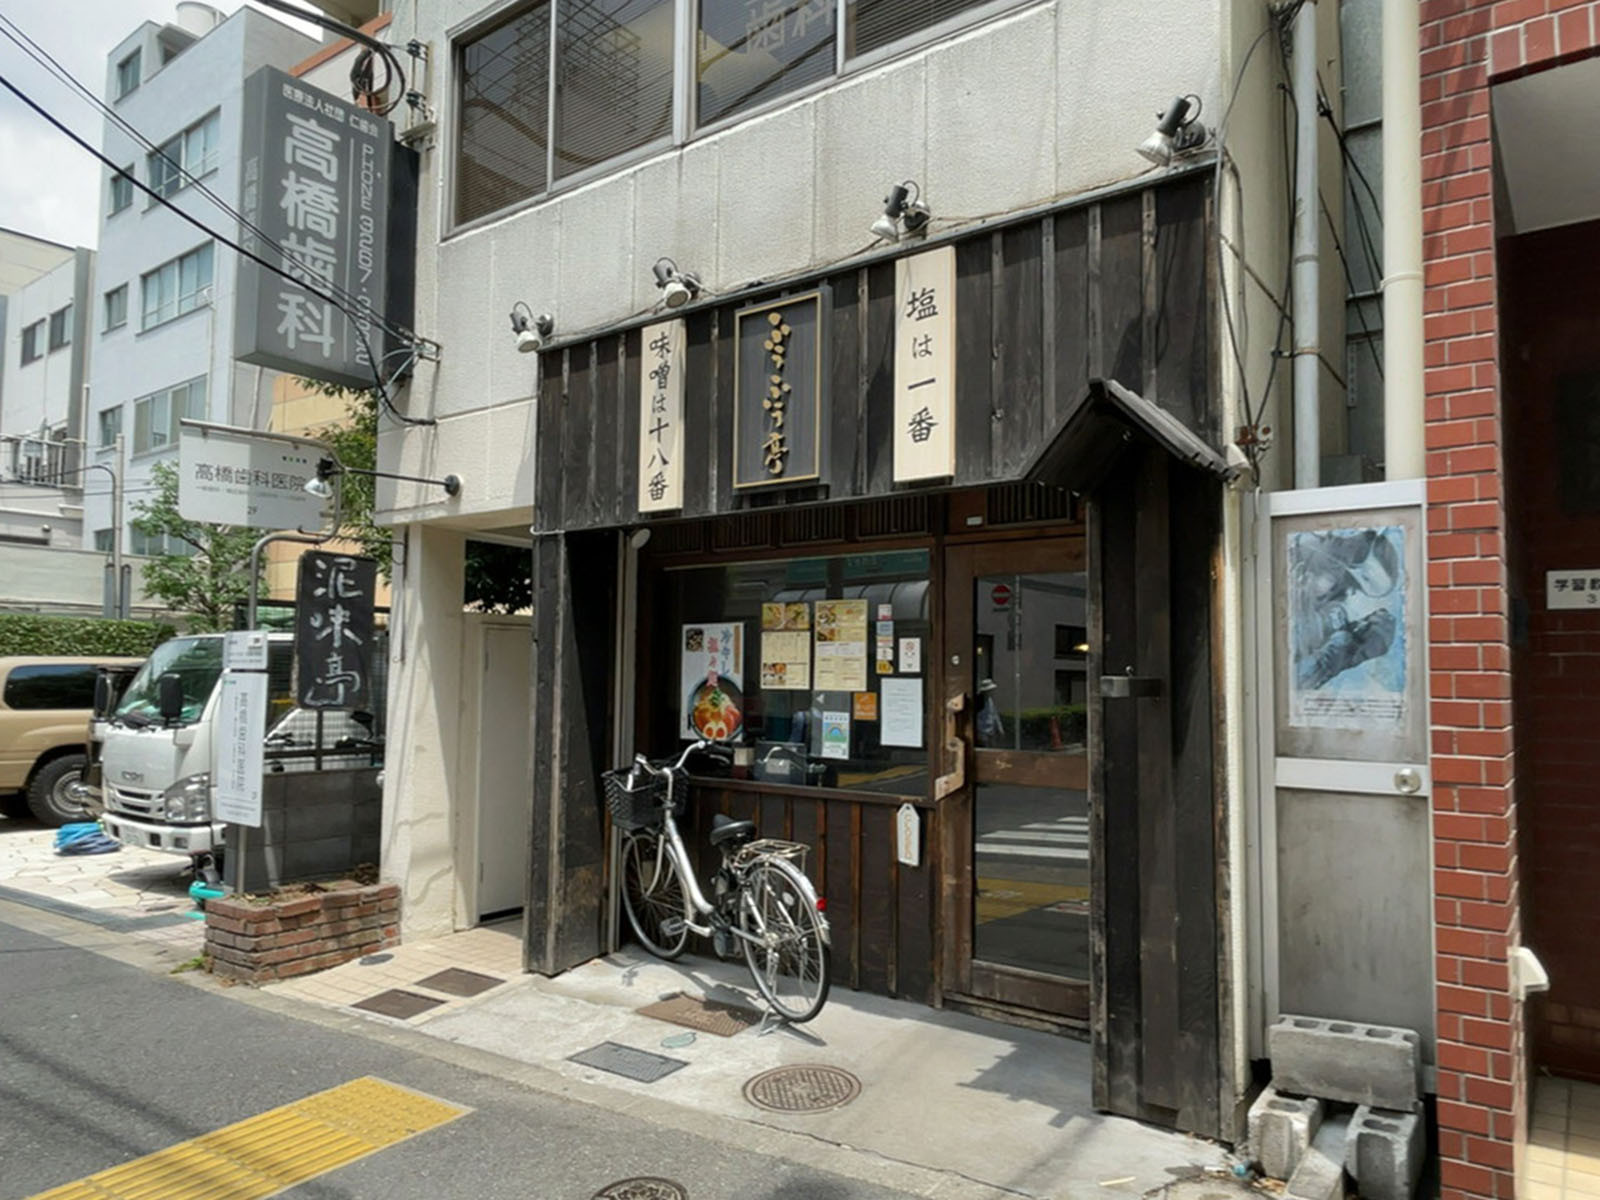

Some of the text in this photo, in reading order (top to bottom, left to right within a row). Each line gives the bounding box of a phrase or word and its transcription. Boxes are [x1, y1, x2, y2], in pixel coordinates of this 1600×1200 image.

[278, 113, 341, 357] 高橋歯科
[649, 333, 671, 501] 味噌は十八番
[907, 287, 938, 443] 塩は一番
[195, 463, 307, 493] 高橋歯科医院
